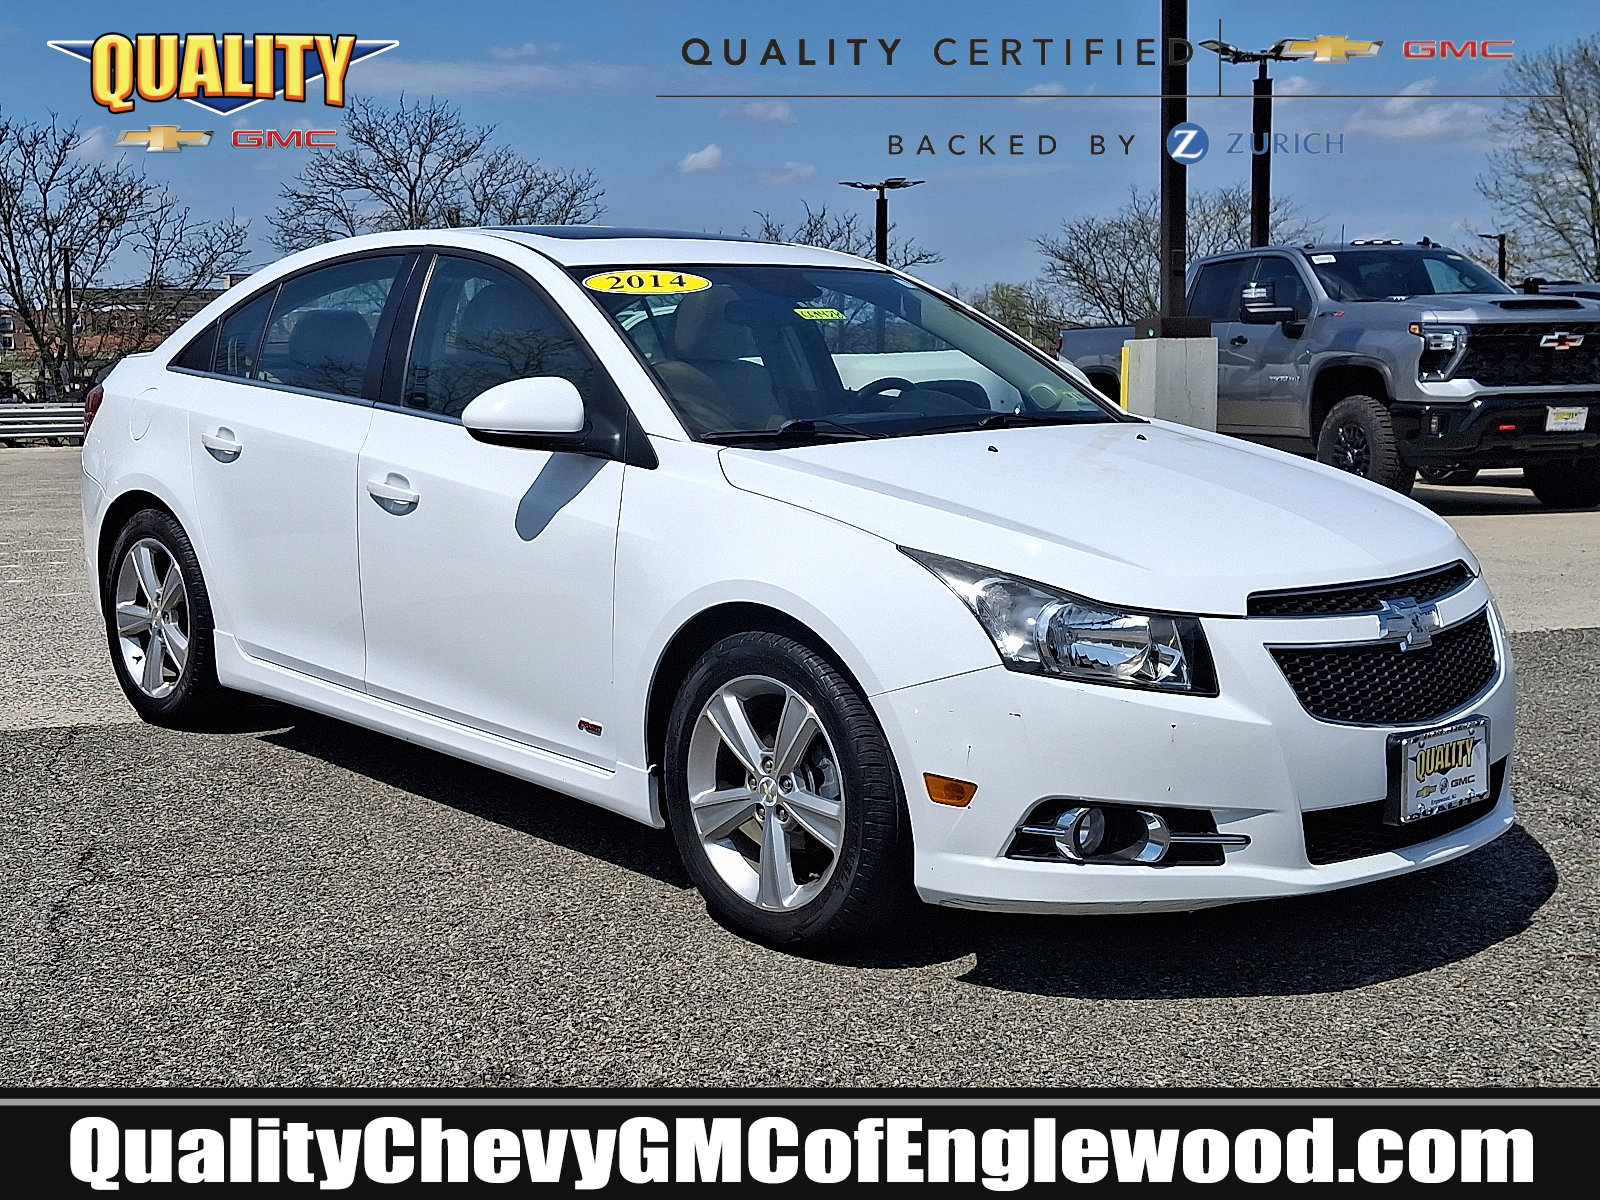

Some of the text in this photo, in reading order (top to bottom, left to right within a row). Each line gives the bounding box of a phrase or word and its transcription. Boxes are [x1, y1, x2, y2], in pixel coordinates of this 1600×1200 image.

[606, 273, 688, 291] 2014
[1415, 737, 1475, 783] QUALITY
[1450, 774, 1476, 788] GMC
